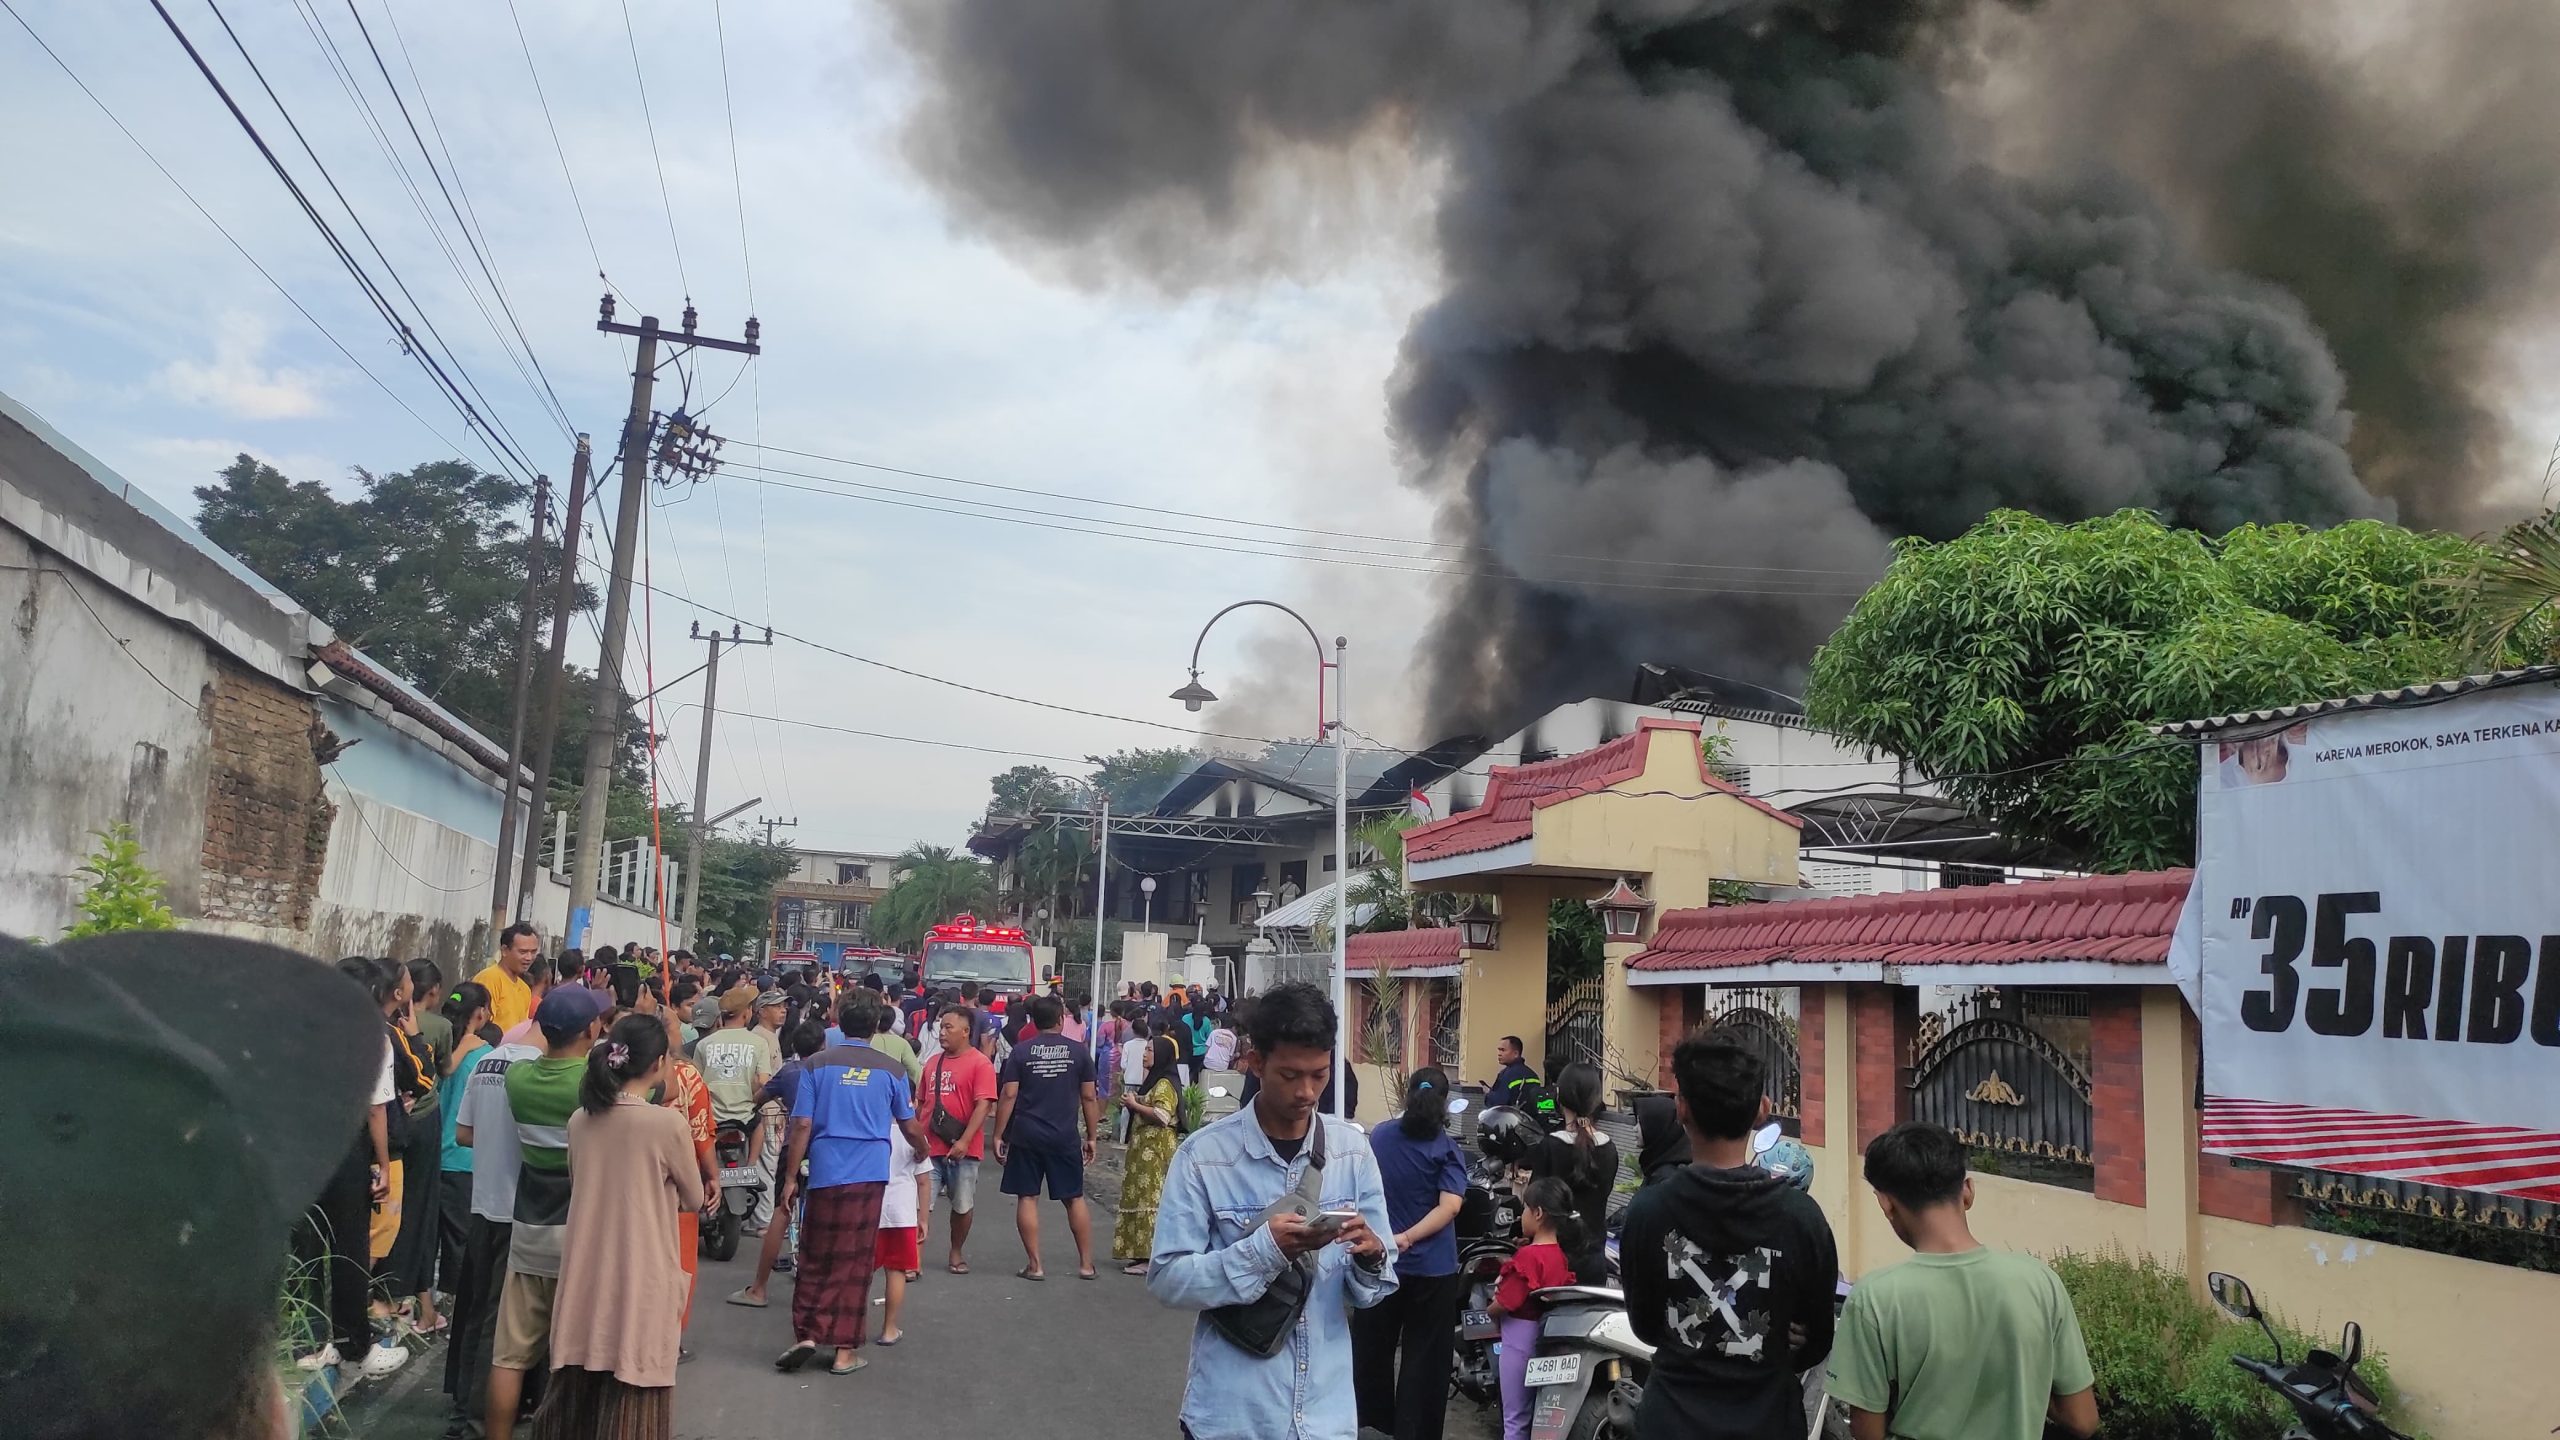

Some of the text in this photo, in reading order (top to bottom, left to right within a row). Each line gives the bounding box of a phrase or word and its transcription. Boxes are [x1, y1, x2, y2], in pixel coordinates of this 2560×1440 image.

[2315, 746, 2363, 763] KARENA
[2365, 737, 2433, 757] MEROKOK,
[2436, 731, 2470, 748] SAYA
[2474, 721, 2541, 742] TERKENA
[943, 942, 1016, 953] BPBD JOMBANG
[2230, 897, 2251, 919] RP
[2241, 891, 2381, 1037] 35
[1466, 1314, 1474, 1326] S
[1528, 1361, 1535, 1374] S
